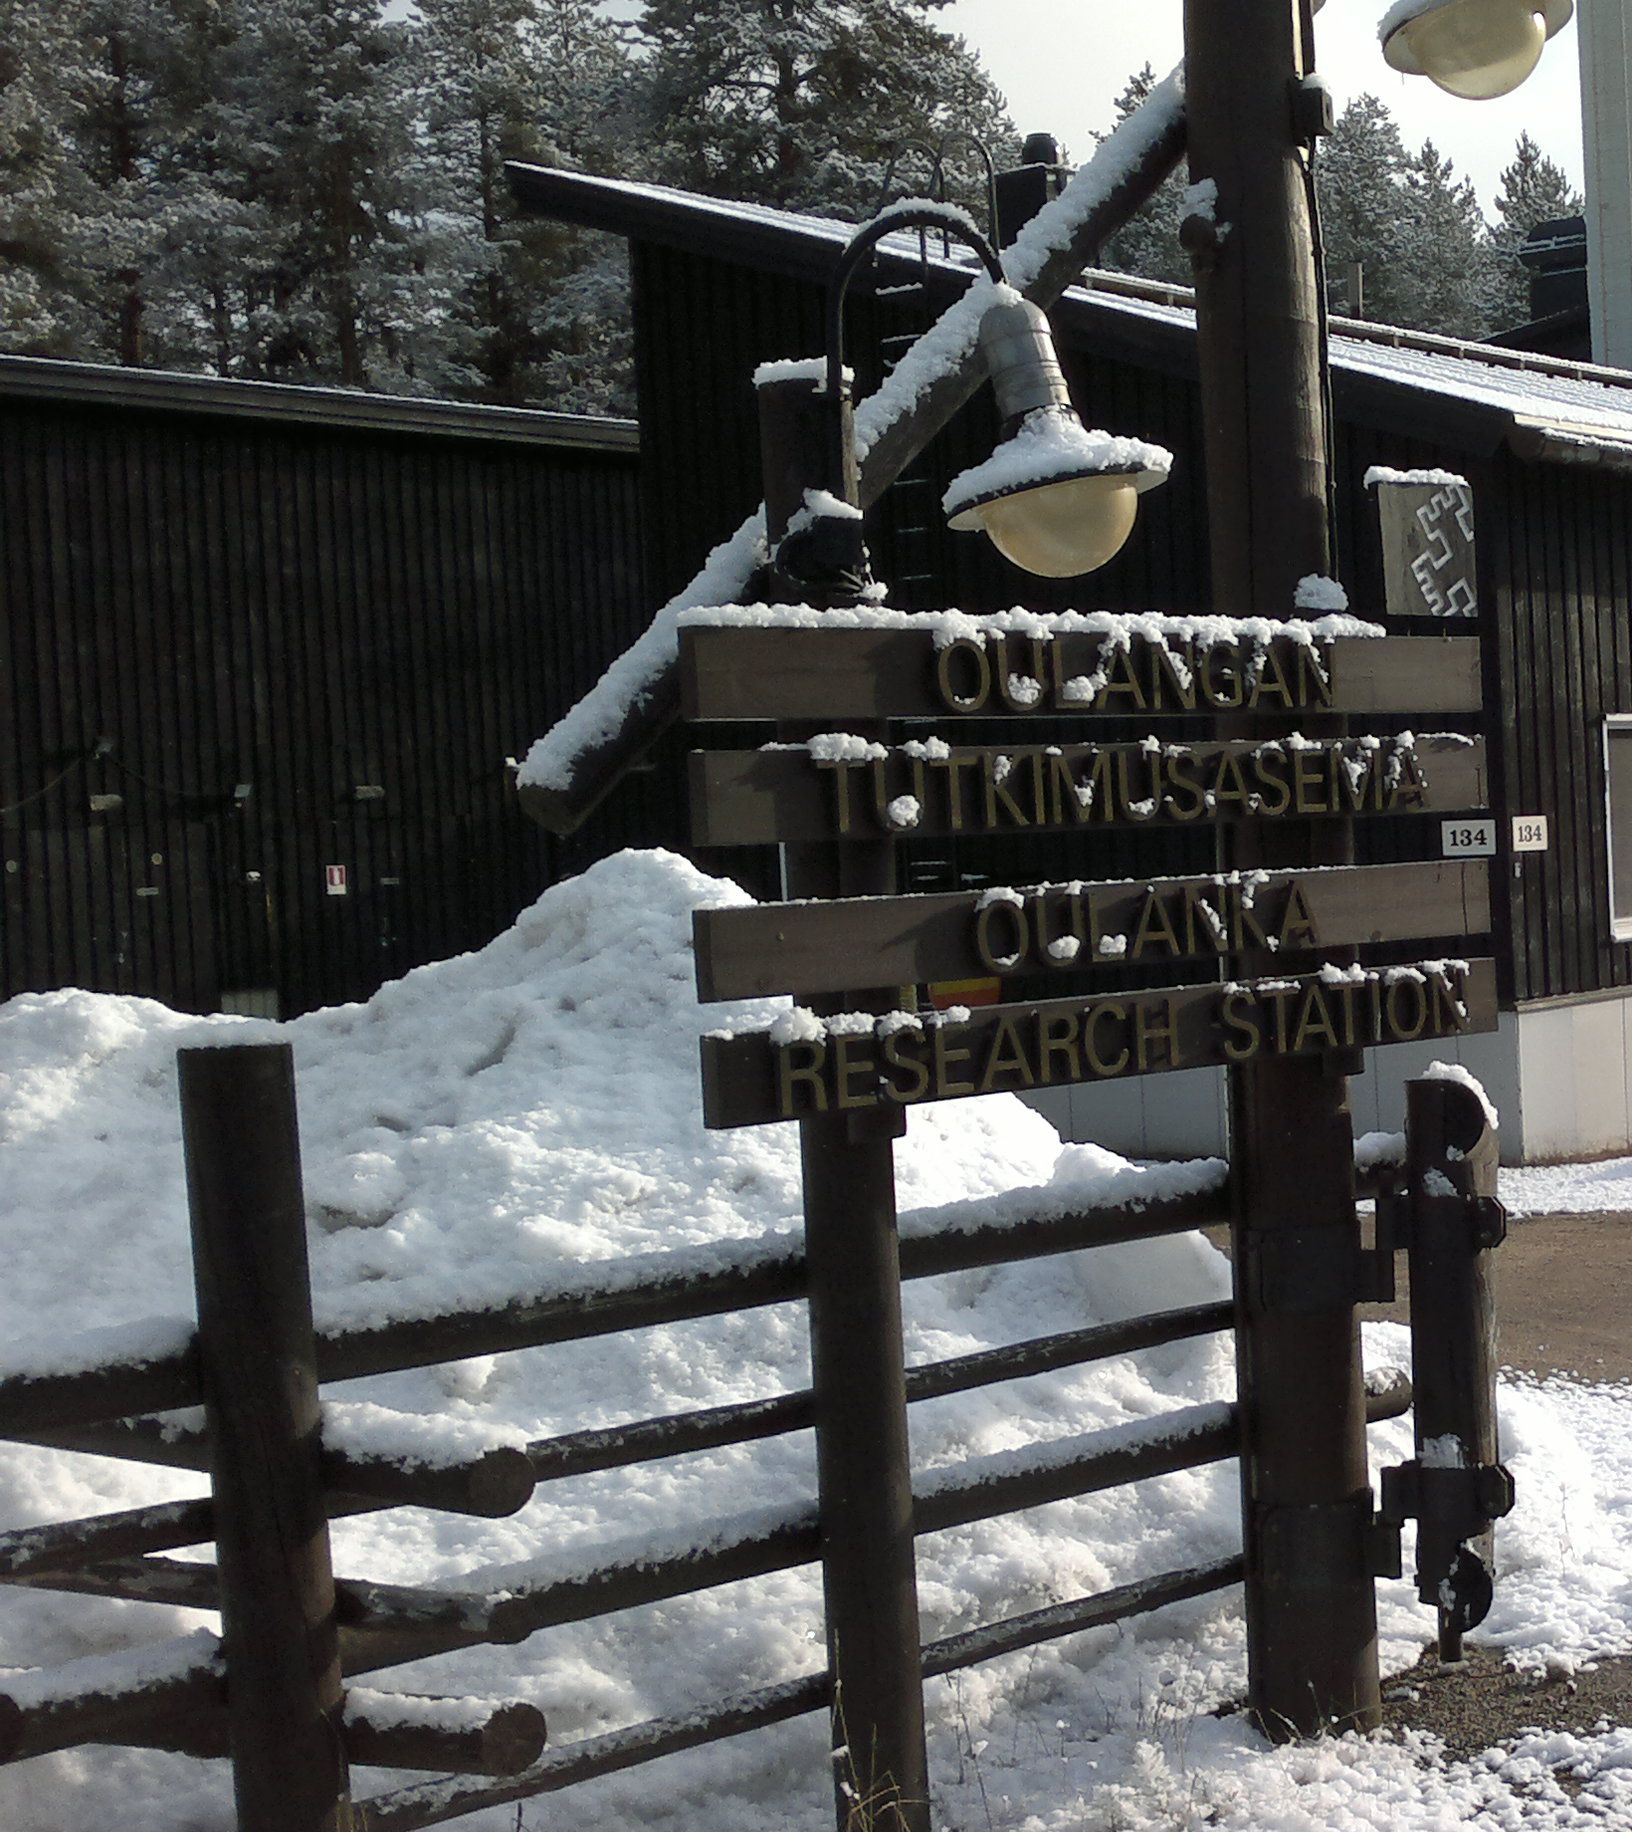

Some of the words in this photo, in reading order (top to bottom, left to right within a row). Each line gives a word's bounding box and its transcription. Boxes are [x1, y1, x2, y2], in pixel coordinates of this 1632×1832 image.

[937, 632, 1335, 713] OULANGAN
[816, 742, 1430, 832] TUTKIMUSASEMA
[1449, 828, 1488, 847] 134
[1517, 824, 1543, 843] 134
[976, 878, 1320, 972] OULANKA
[779, 997, 1184, 1115] RESEARCH
[1221, 965, 1469, 1060] STATION
